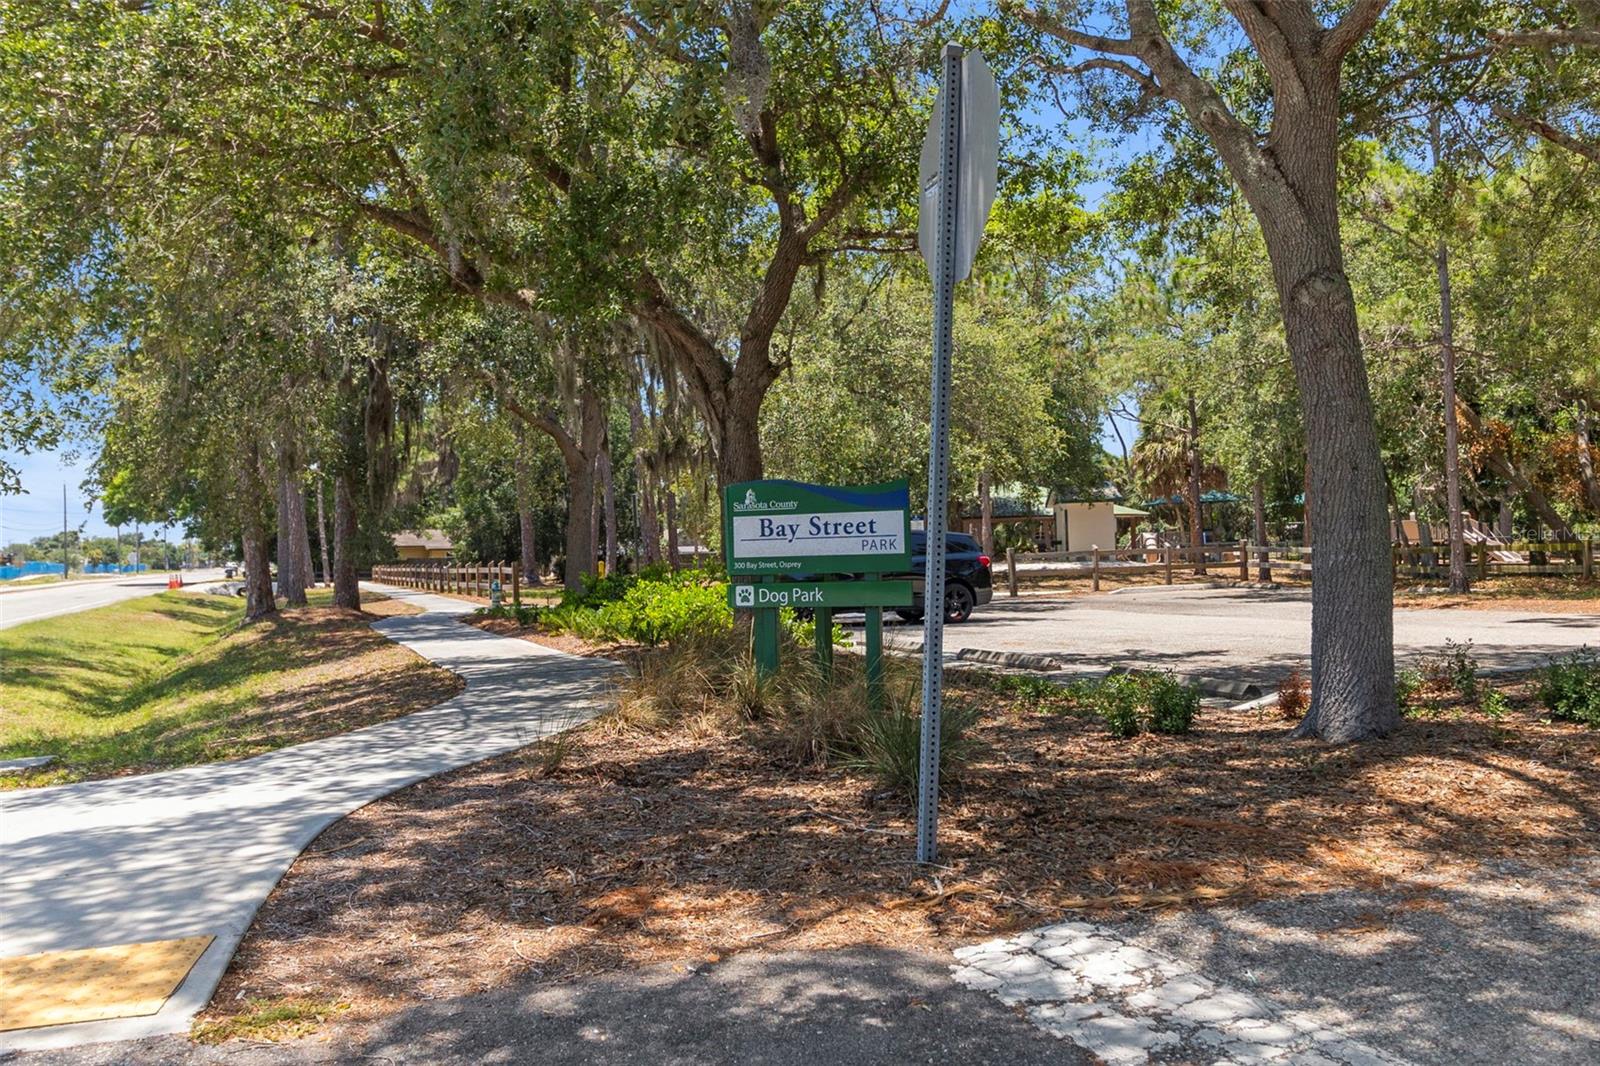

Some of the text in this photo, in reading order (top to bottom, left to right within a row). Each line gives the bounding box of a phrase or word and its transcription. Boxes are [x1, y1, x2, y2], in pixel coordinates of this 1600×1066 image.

[769, 500, 798, 510] County
[759, 516, 877, 543] Bay Street
[861, 538, 897, 551] PARK
[746, 561, 757, 570] Bay
[779, 560, 801, 569] Osprey
[759, 587, 824, 605] Dog Park
